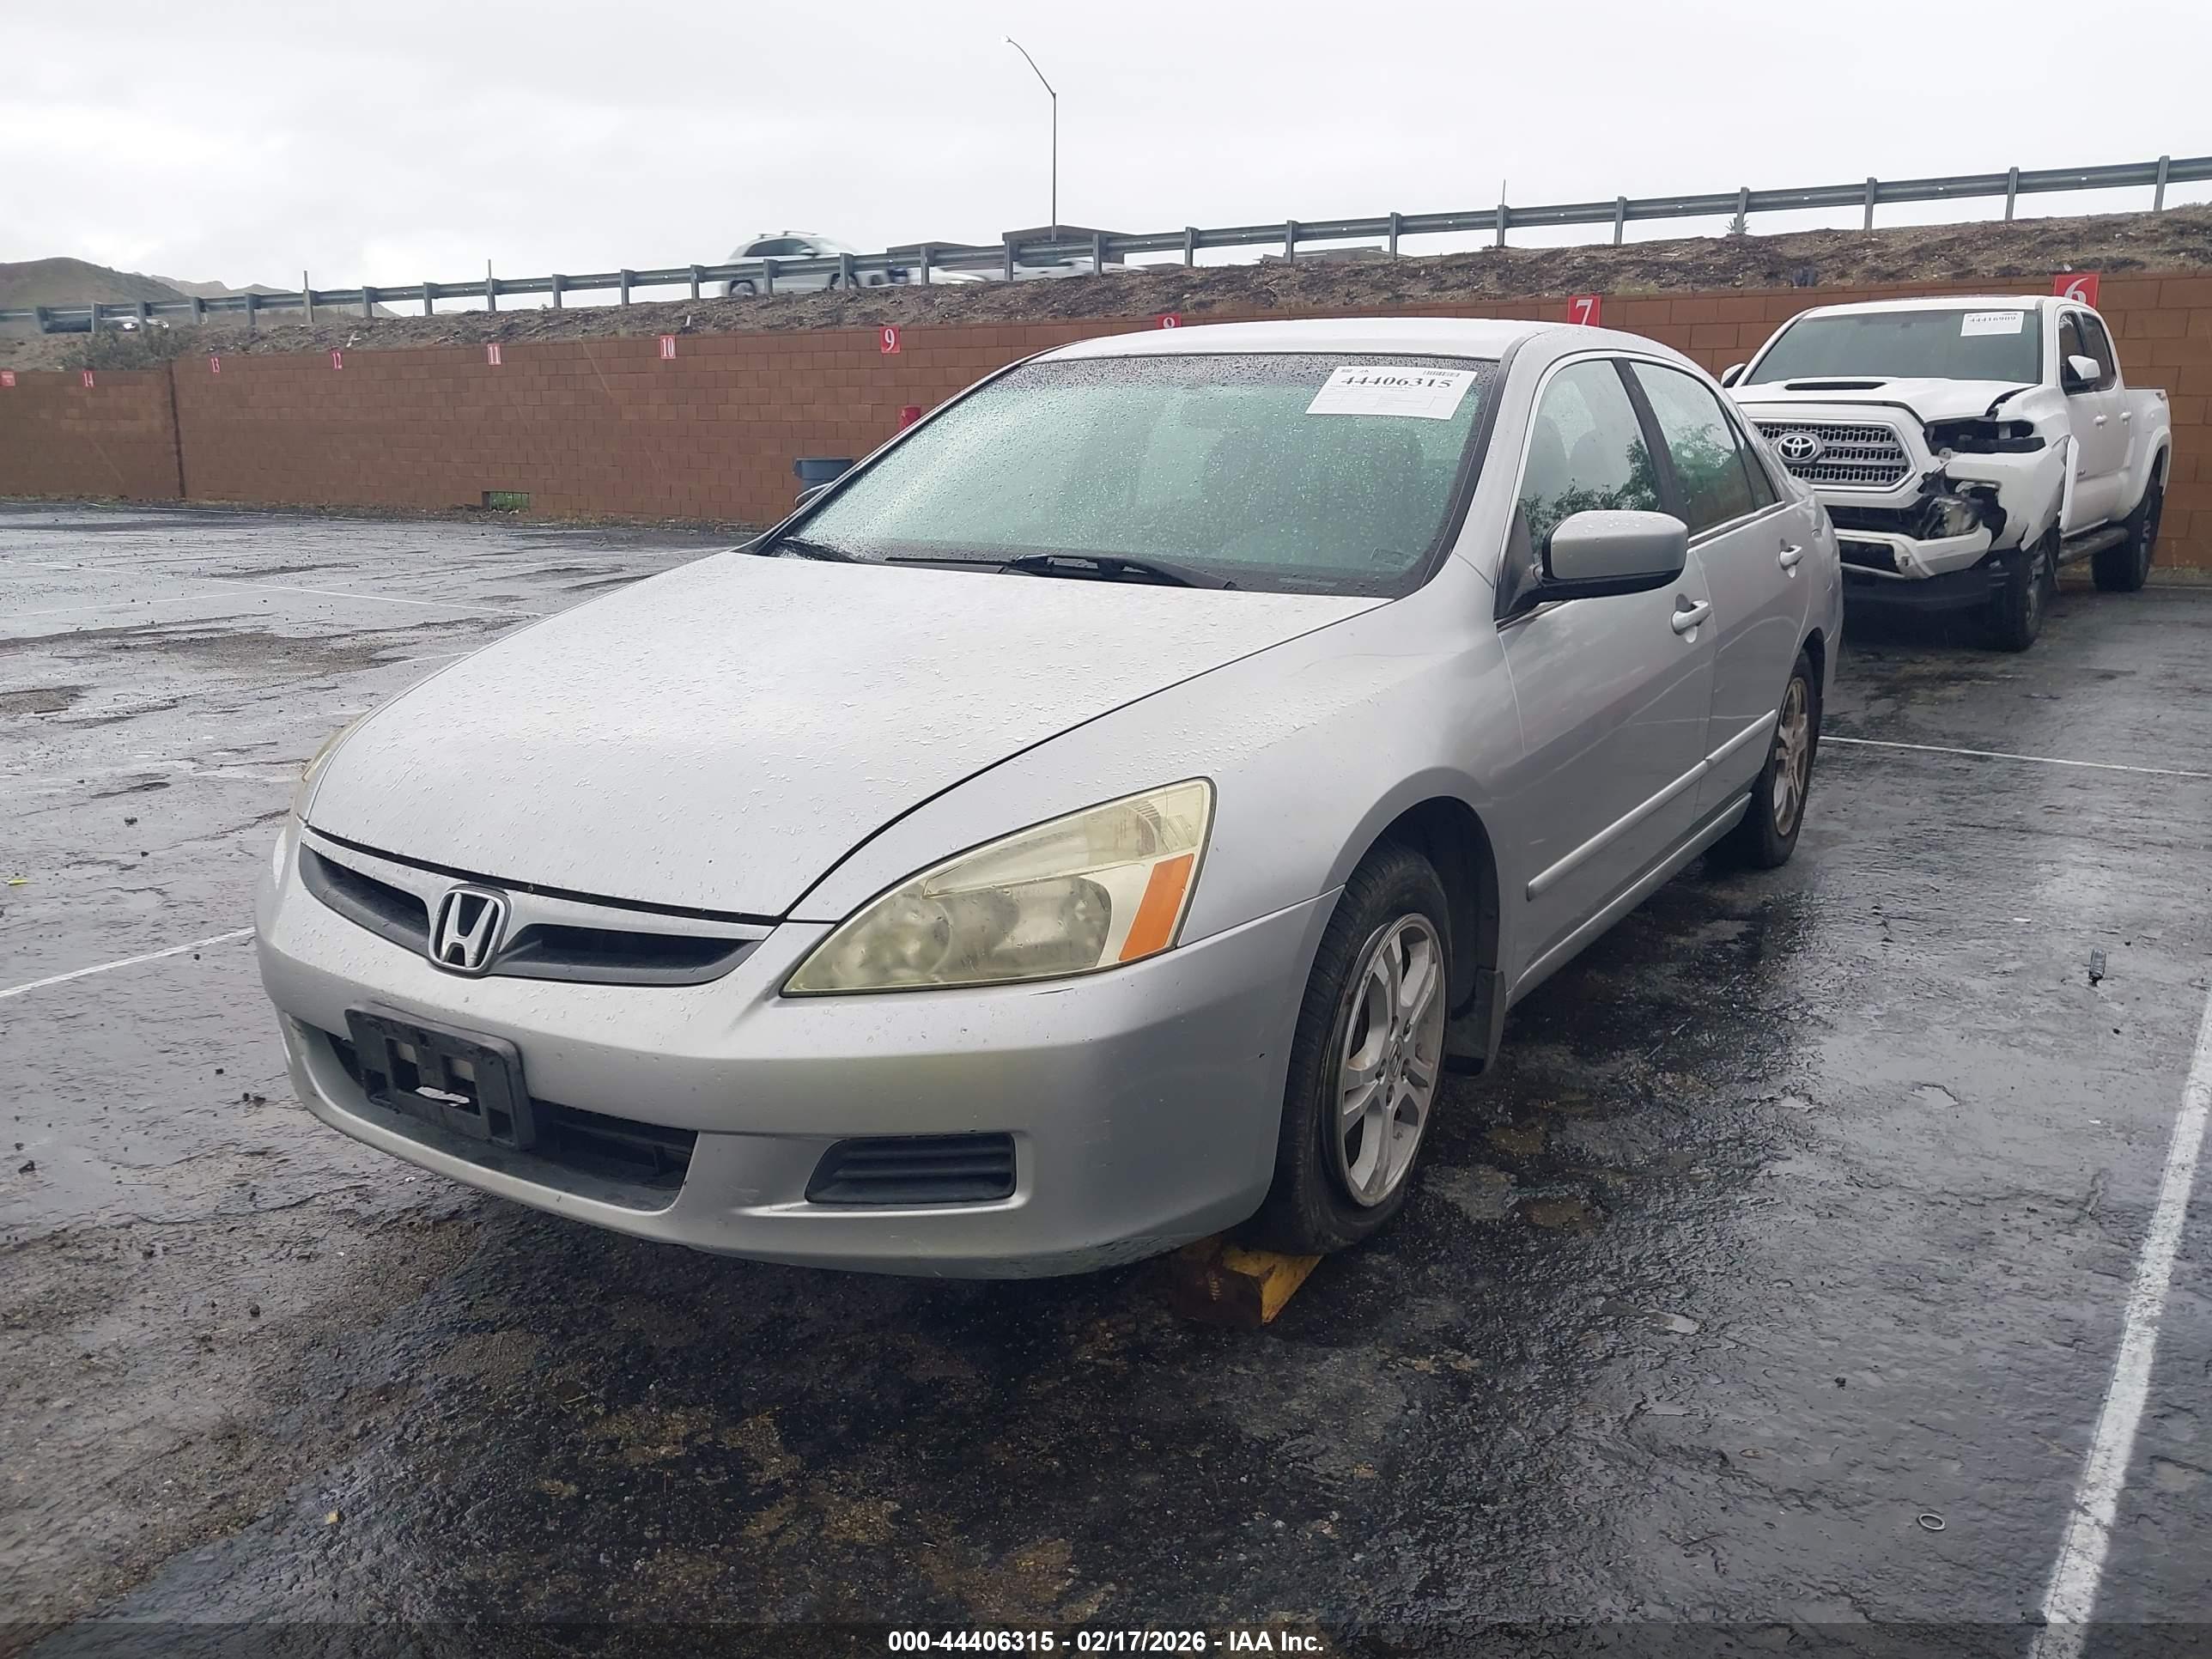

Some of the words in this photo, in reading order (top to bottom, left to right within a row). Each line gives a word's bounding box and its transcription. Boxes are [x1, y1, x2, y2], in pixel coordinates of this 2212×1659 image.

[1575, 299, 1593, 325] 7
[661, 337, 674, 357] 10
[884, 328, 895, 351] 9
[489, 345, 501, 364] 11
[1340, 376, 1453, 388] 44406315
